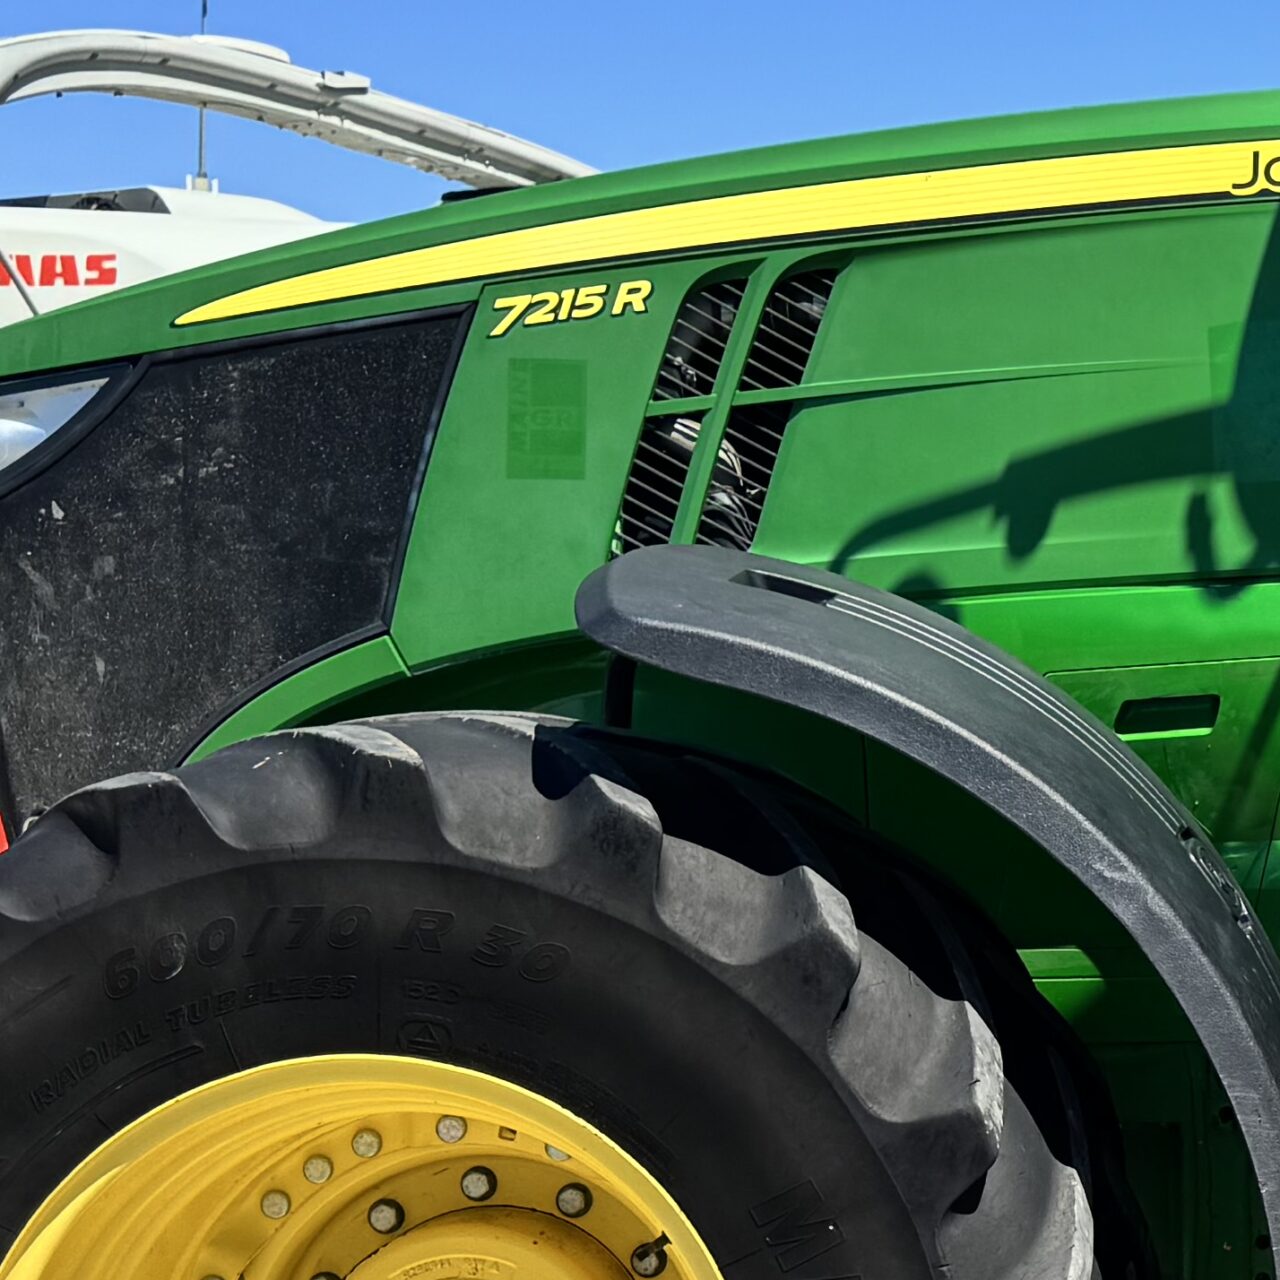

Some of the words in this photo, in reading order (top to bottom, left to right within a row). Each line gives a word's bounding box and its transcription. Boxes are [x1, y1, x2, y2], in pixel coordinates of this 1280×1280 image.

[485, 282, 611, 339] 7215
[610, 279, 655, 318] R
[103, 903, 374, 1001] 600/70
[395, 908, 456, 954] R
[471, 922, 572, 984] 30
[28, 1021, 153, 1115] RADIAL
[165, 974, 359, 1036] TUBELESS
